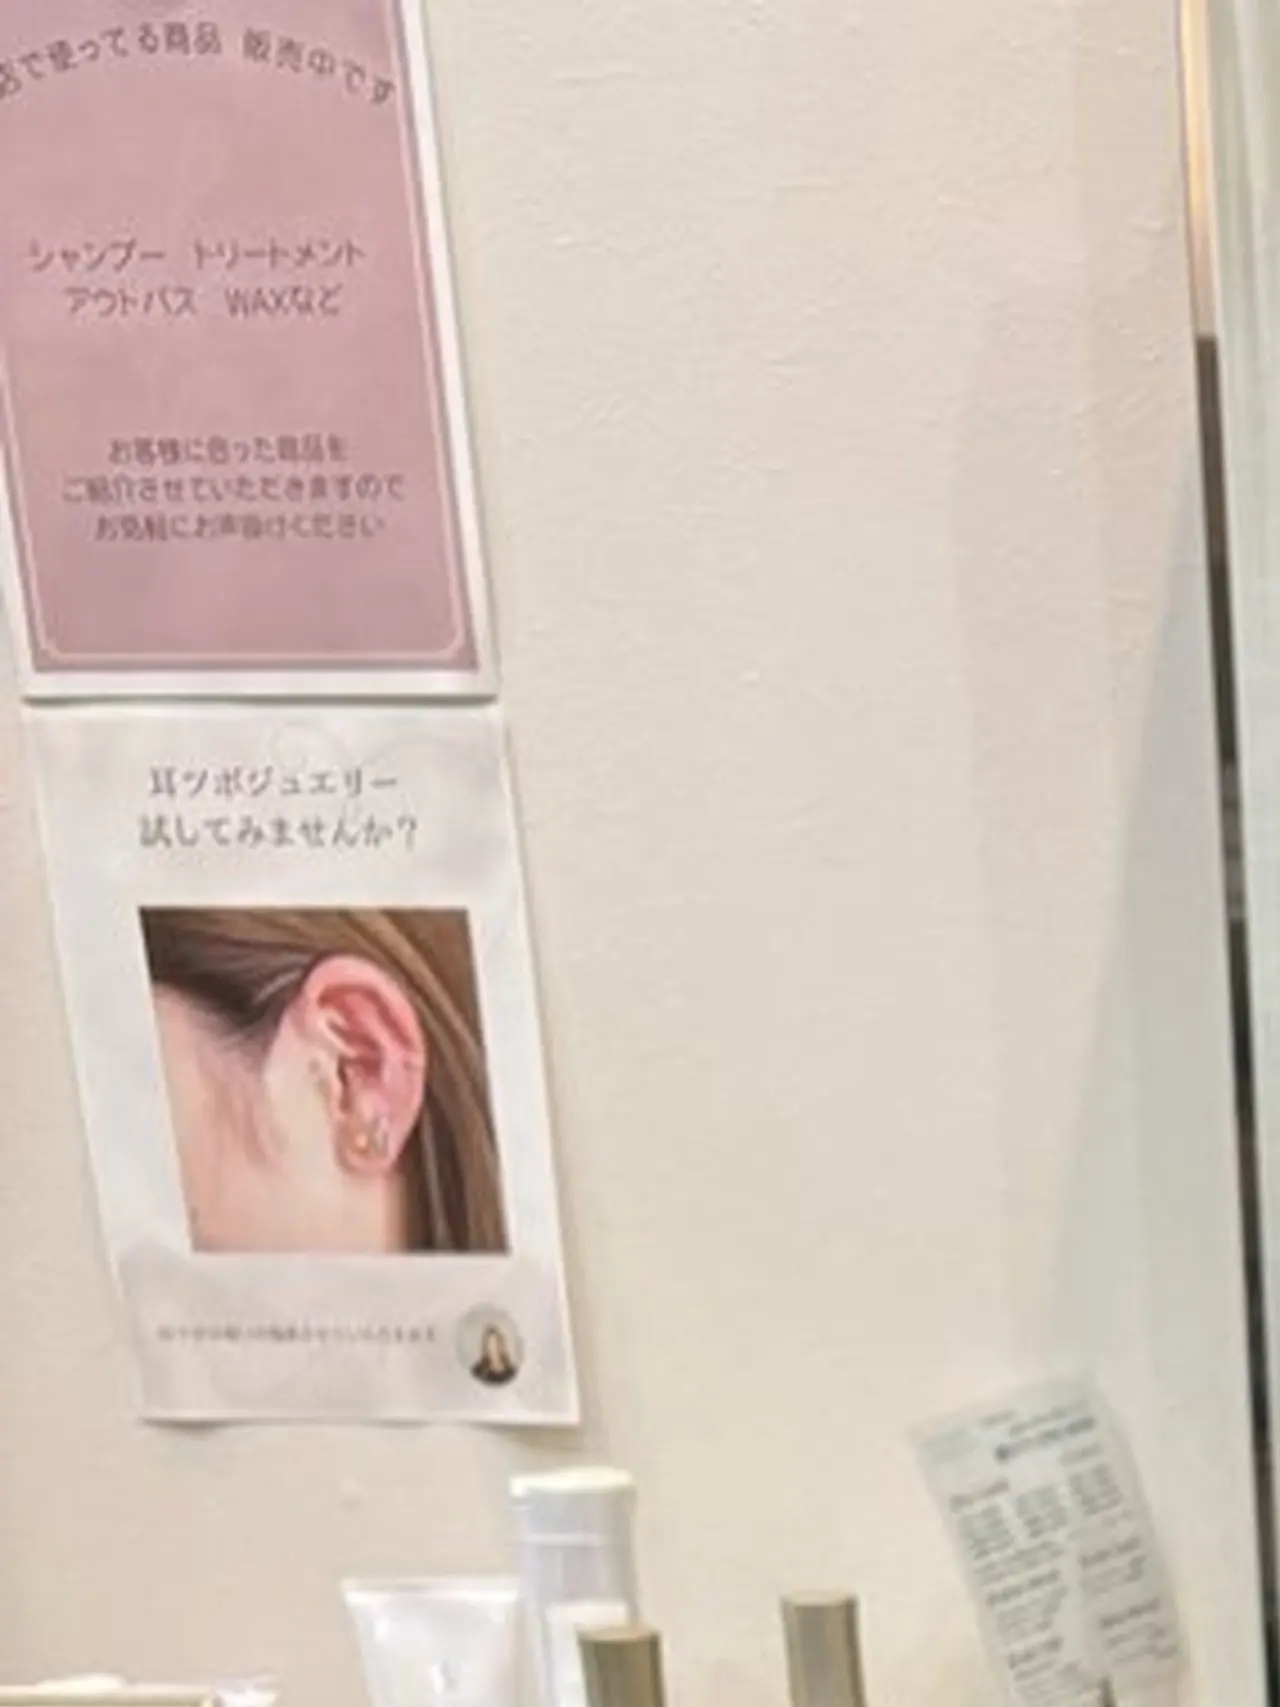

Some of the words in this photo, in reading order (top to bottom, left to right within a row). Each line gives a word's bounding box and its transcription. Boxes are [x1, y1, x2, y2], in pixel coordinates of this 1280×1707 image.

[241, 26, 396, 105] 販売中です
[27, 238, 166, 273] シャンプー
[193, 238, 366, 271] トリートメント
[64, 285, 198, 317] アウトバス
[223, 283, 344, 317] WAXなど
[149, 765, 398, 799] 耳ツボジュエリー
